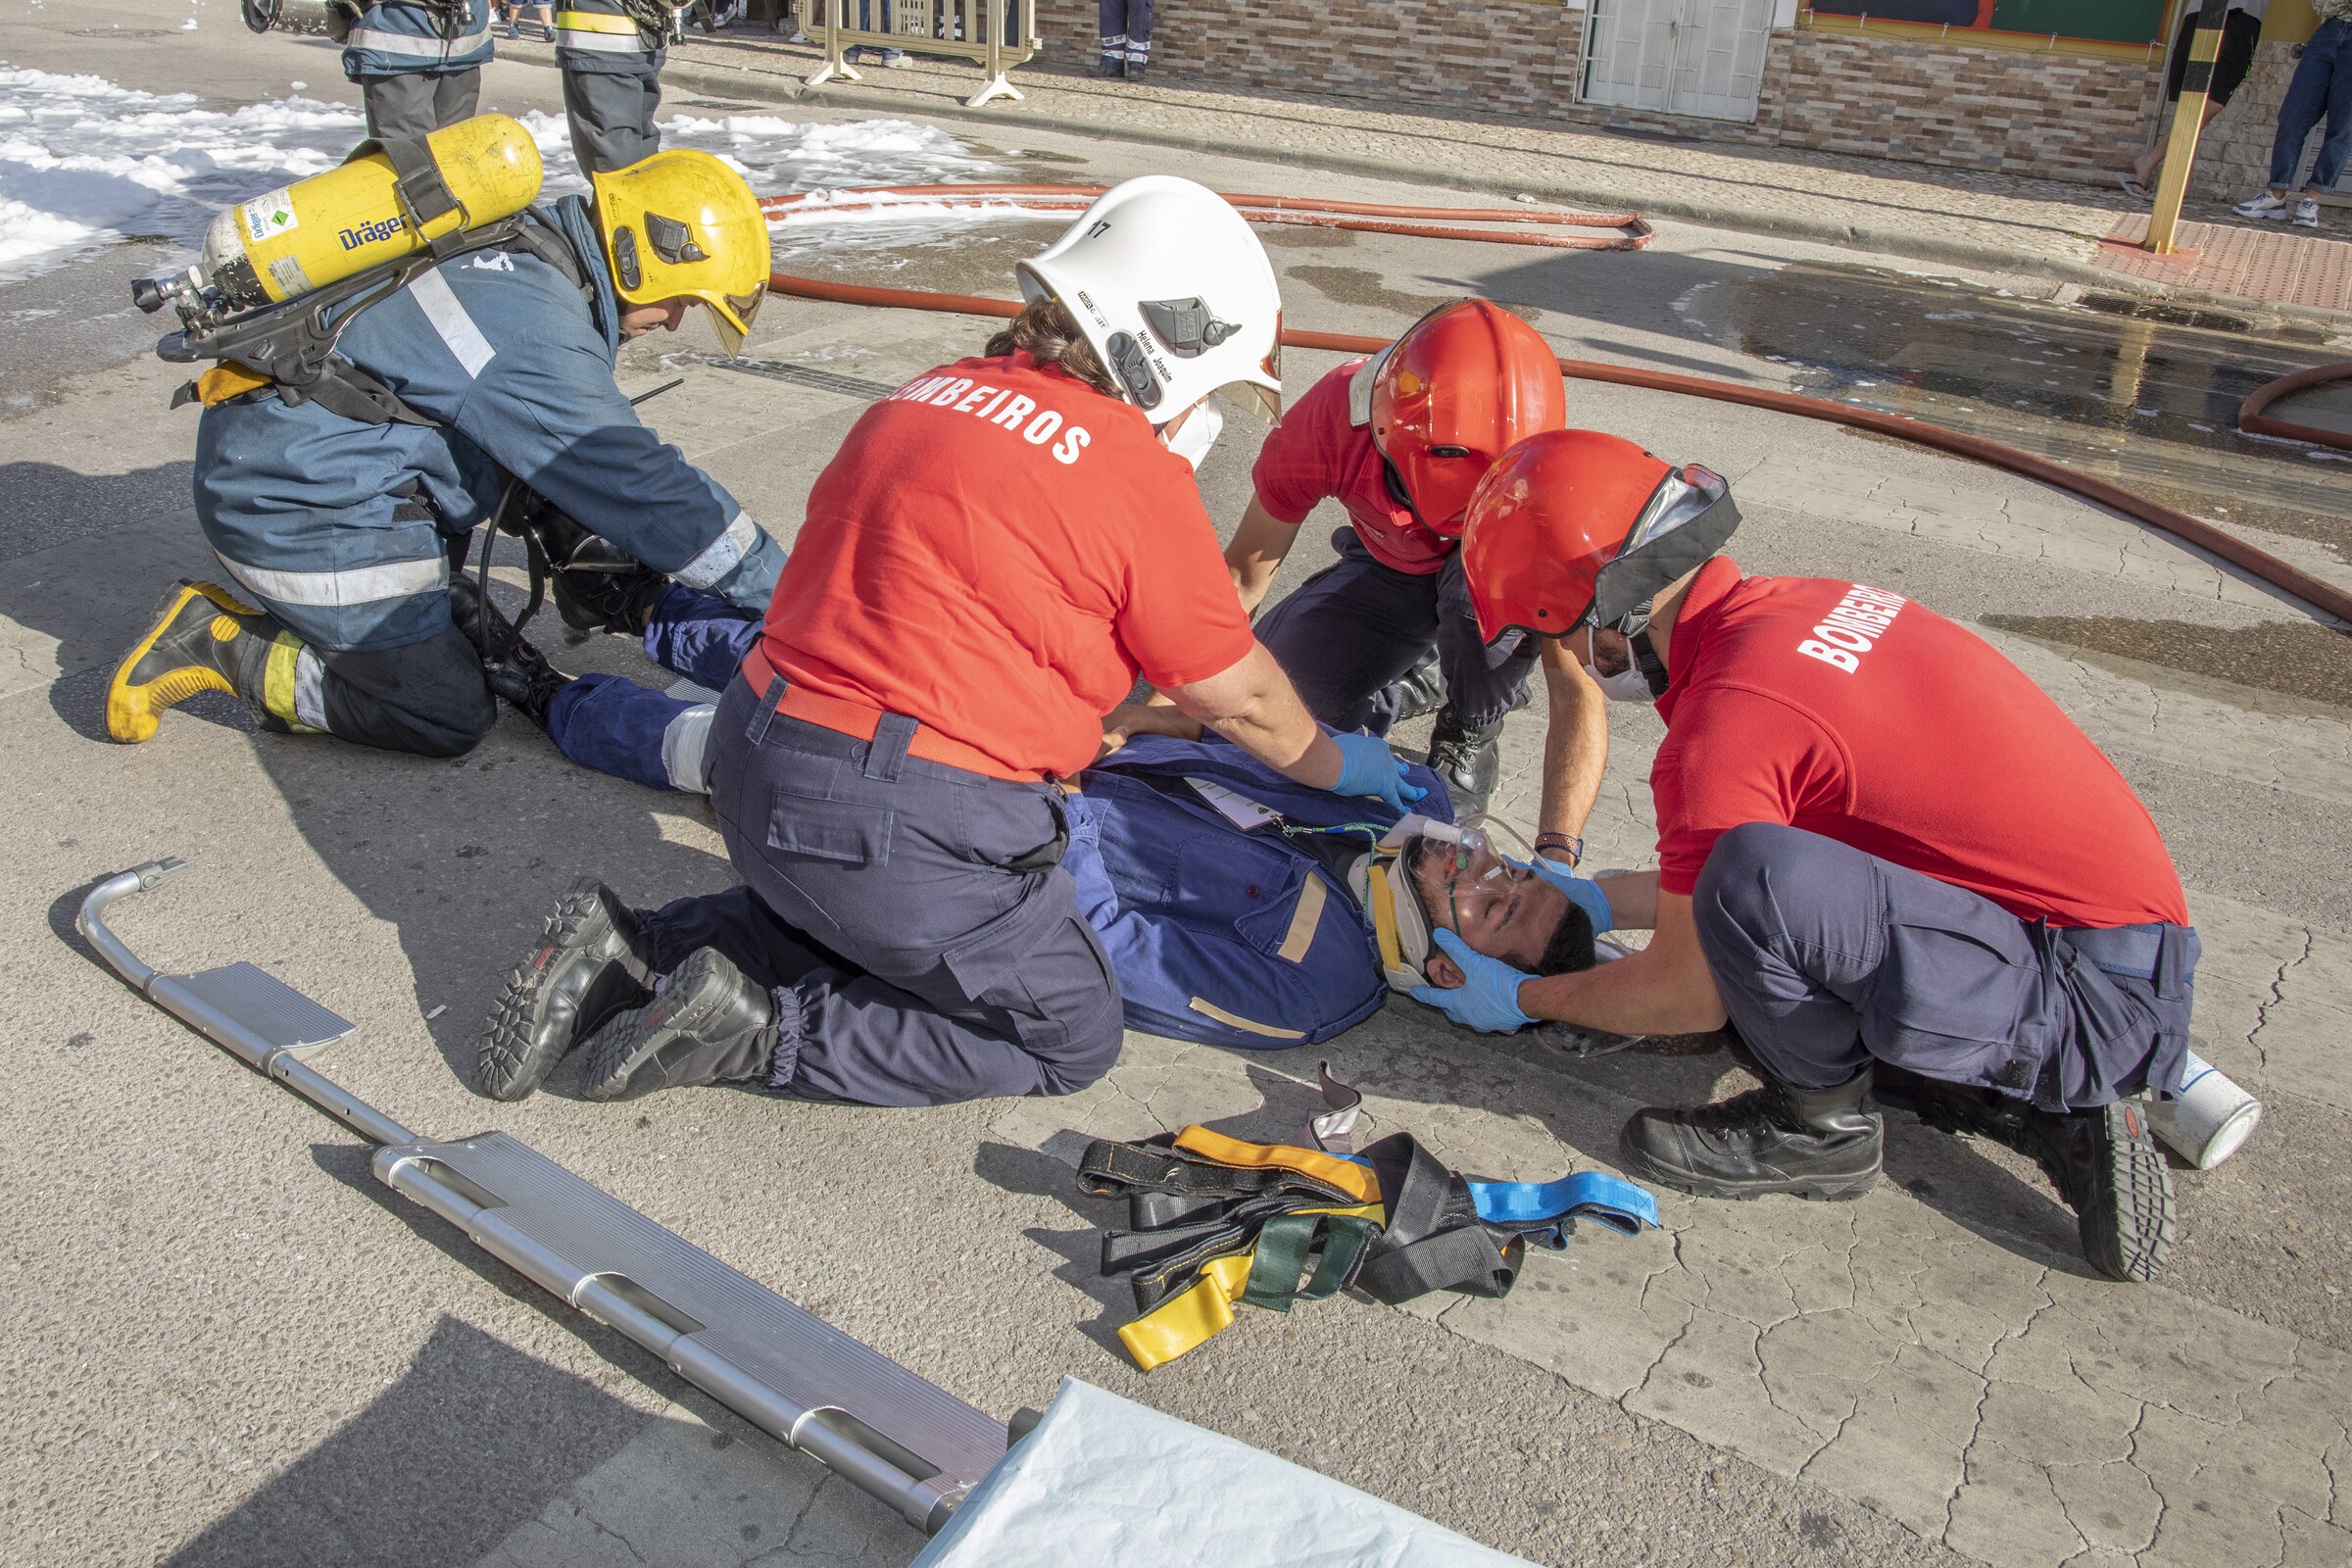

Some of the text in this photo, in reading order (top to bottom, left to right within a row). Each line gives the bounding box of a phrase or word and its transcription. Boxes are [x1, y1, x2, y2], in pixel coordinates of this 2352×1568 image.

[250, 213, 265, 239] Dräger
[338, 214, 408, 251] Dräger
[1087, 220, 1111, 239] 17
[1078, 290, 1094, 310] MSA
[1090, 308, 1106, 328] GLET
[1137, 329, 1172, 383] Helena Joaquim
[886, 376, 1091, 466] OMBEIROS
